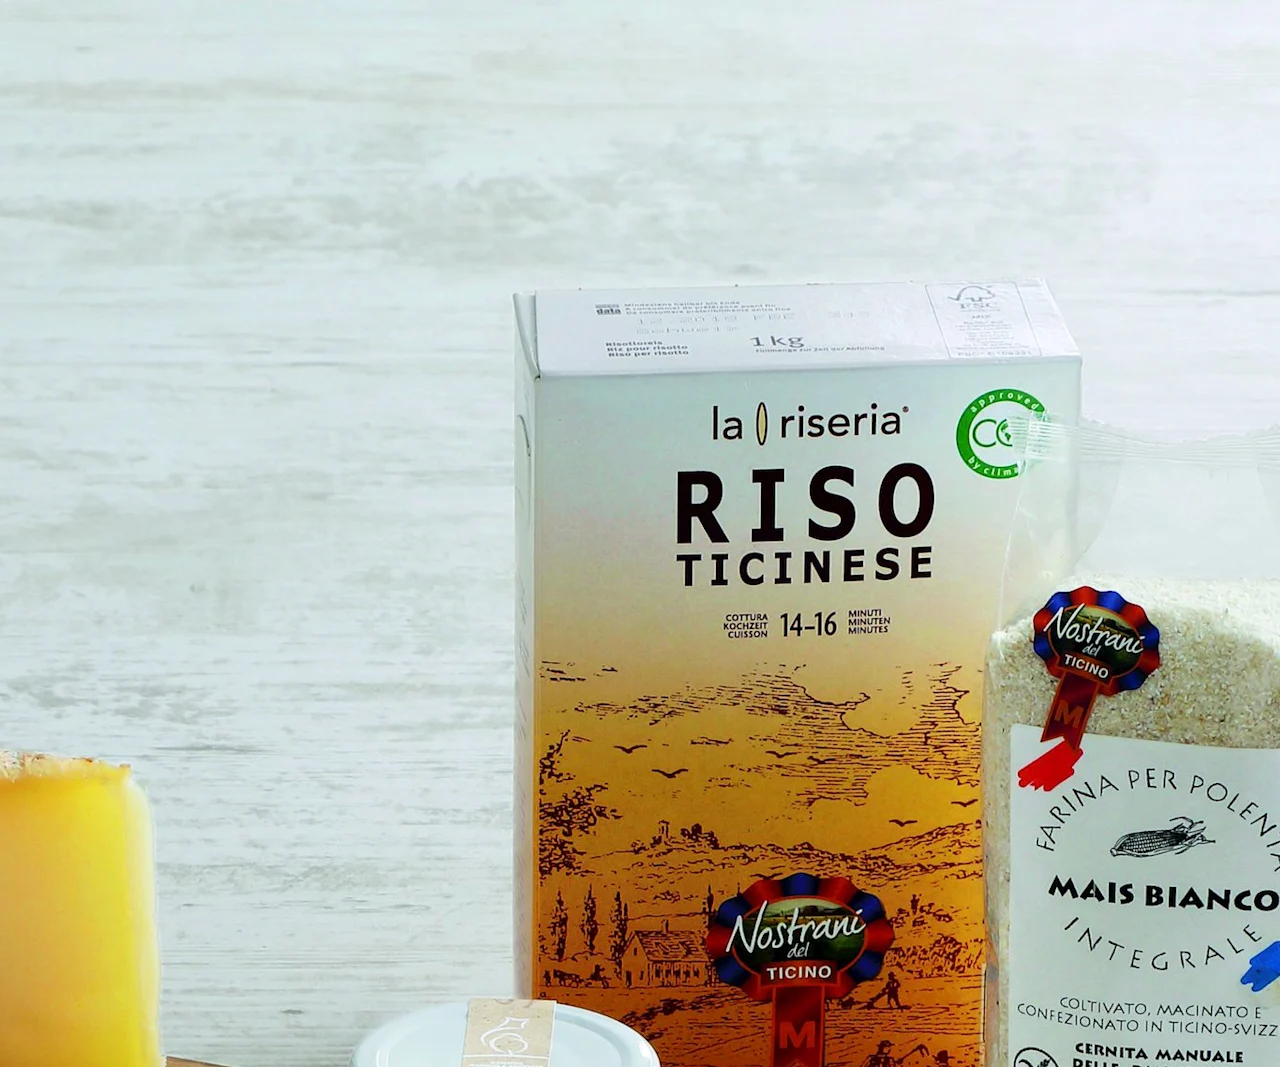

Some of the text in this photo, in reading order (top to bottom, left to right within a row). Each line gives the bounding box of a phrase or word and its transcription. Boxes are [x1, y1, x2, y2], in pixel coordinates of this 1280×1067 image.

[750, 335, 805, 348] 1 kg
[970, 391, 1040, 413] approved
[712, 405, 743, 440] la
[968, 456, 980, 469] by
[676, 462, 935, 544] RISO
[676, 545, 933, 587] TICINESE
[725, 613, 768, 622] COTTURA
[848, 608, 882, 618] MINUTI
[848, 617, 891, 626] MINUTEN
[723, 621, 768, 631] KOCHZEIT
[727, 630, 768, 639] CUISSON
[848, 625, 889, 635] MINUTES
[1043, 602, 1144, 656] Nostrani
[1082, 642, 1103, 657] del
[1063, 652, 1110, 681] TICINO
[1054, 700, 1082, 729] M
[1036, 774, 1119, 852] FARINA
[1128, 768, 1177, 790] PER
[1048, 875, 1280, 912] MAIS BIANCO
[724, 899, 866, 954] Nostrani
[786, 941, 810, 960] del
[1064, 916, 1262, 971] INTEGRALE
[766, 964, 832, 981] TICINO
[1017, 1003, 1140, 1033] CONFEZIONATO
[1145, 1020, 1163, 1033] IN
[1059, 996, 1262, 1020] COLTIVATO, MACINATO E
[779, 1022, 816, 1049] M
[1075, 1042, 1244, 1064] CERNITA MANUALE
